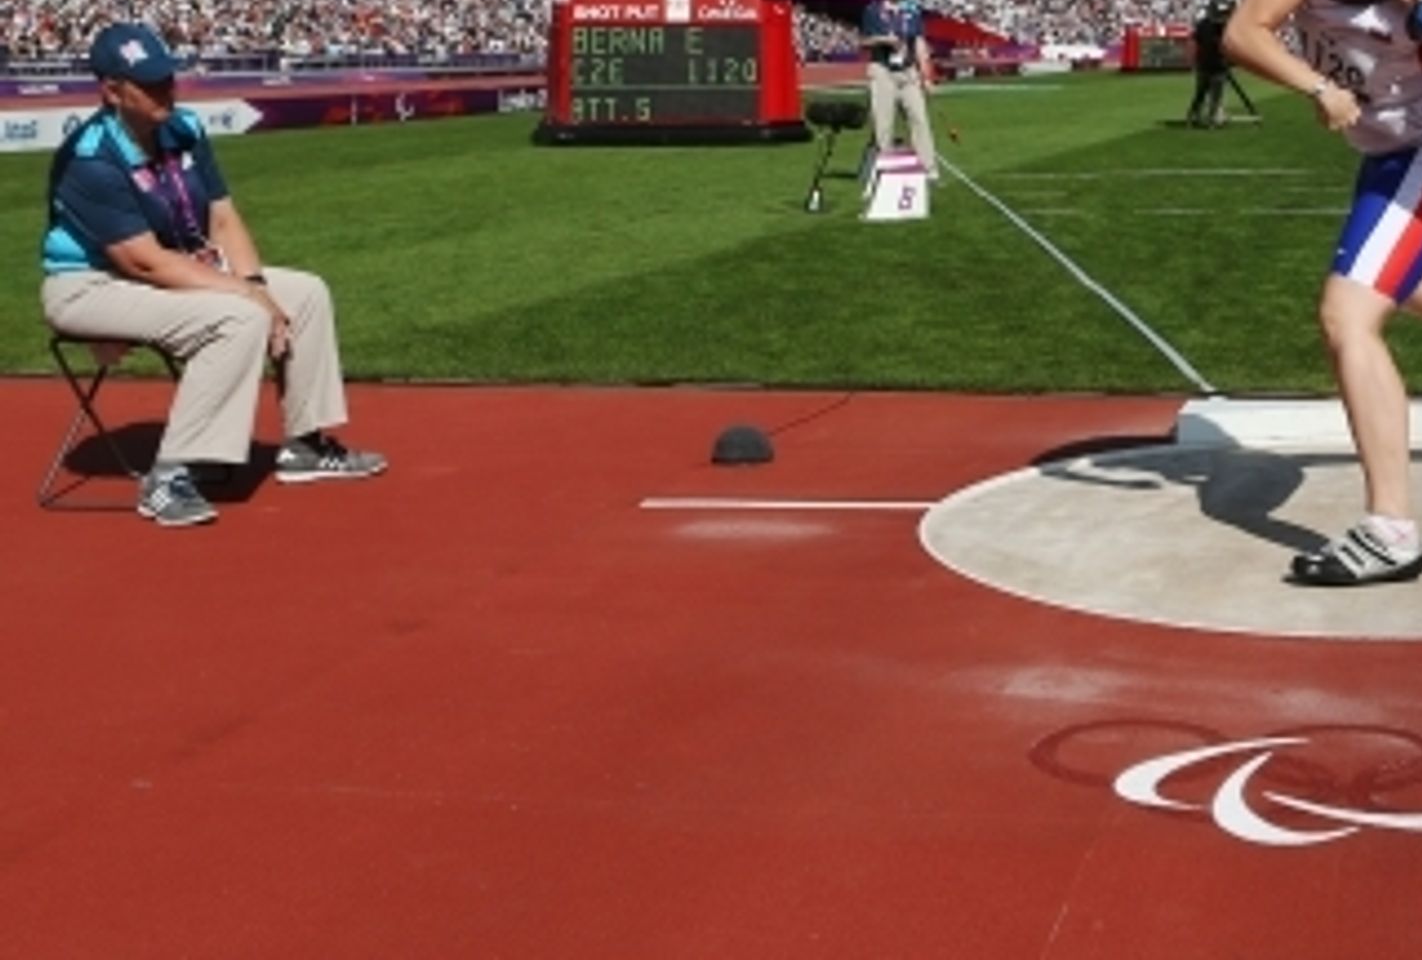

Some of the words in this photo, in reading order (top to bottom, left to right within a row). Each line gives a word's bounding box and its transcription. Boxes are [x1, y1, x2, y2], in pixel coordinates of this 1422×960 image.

[573, 5, 621, 20] SHOT
[624, 5, 659, 19] PUT
[573, 27, 664, 54] BERNA
[687, 27, 704, 54] E
[573, 58, 624, 85] CZE
[688, 58, 757, 83] 1120
